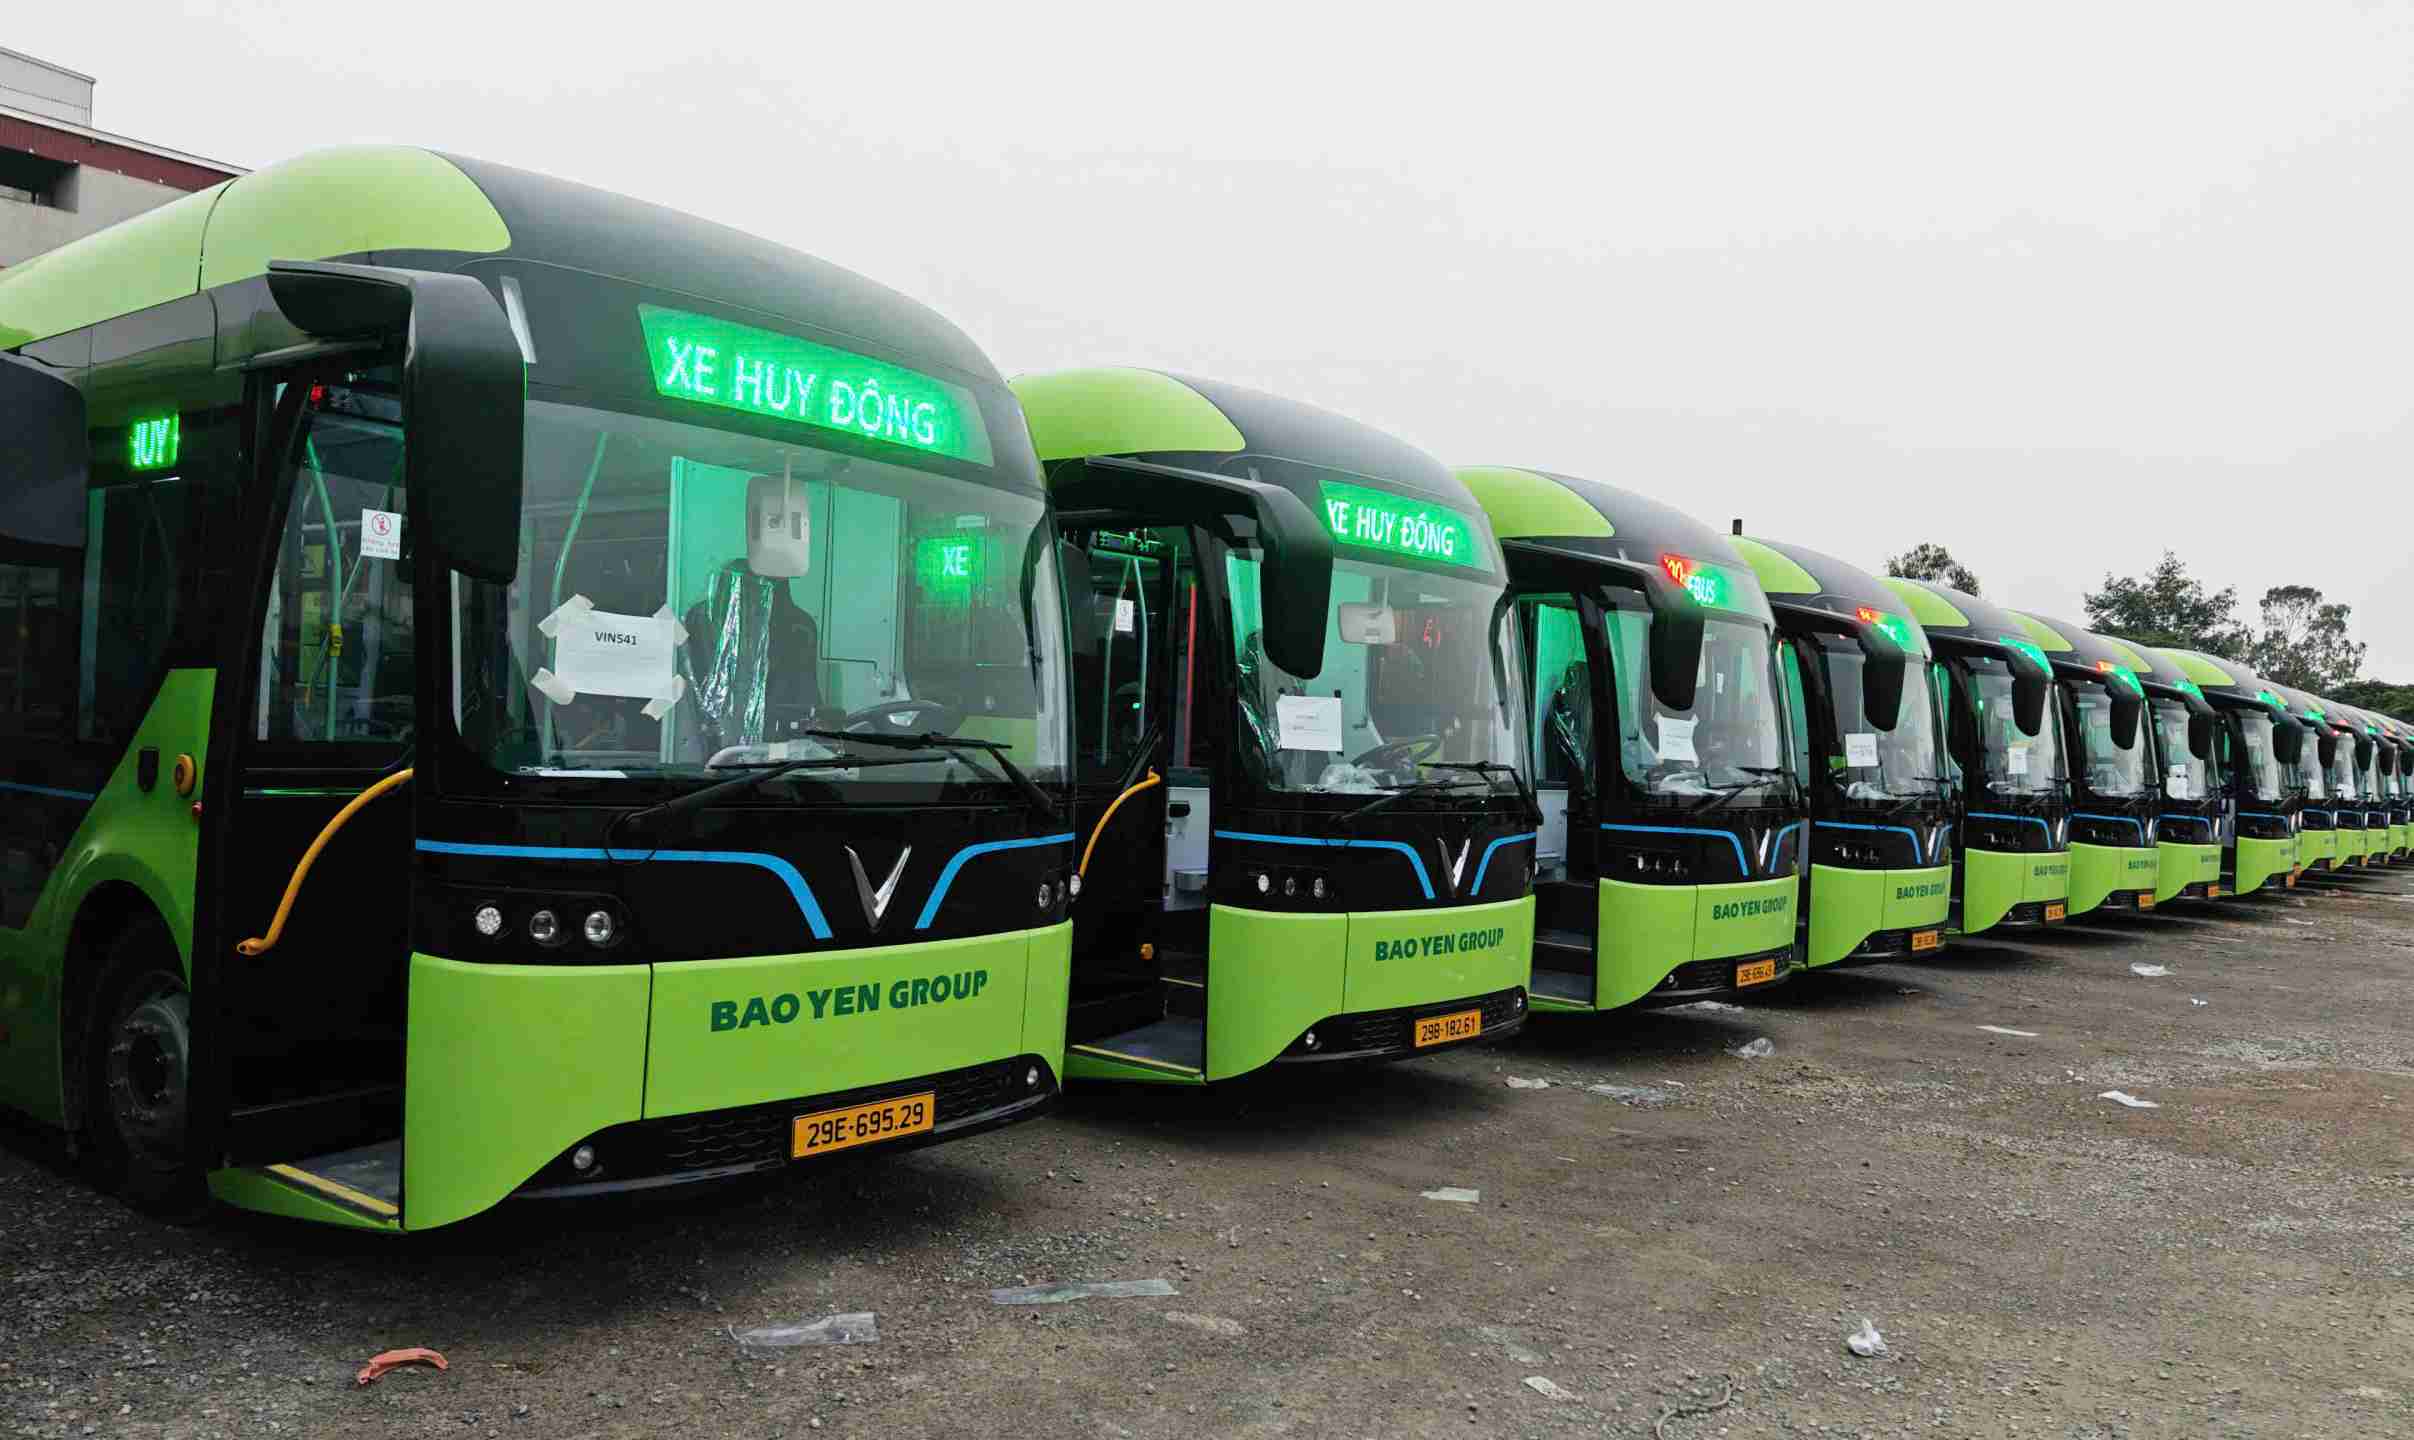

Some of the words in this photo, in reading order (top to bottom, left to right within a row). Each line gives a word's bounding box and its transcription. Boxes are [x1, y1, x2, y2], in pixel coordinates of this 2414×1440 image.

[666, 336, 716, 395] XE
[735, 354, 817, 416] HUY
[830, 378, 936, 445] ĐỘNG
[1355, 505, 1396, 544] HUY
[943, 545, 969, 577] XE
[595, 631, 637, 646] VIN541
[1713, 902, 1739, 920] BAO
[1740, 899, 1761, 917] YEN
[1375, 938, 1418, 962] BAO
[1420, 933, 1455, 957] YEN
[1458, 927, 1504, 952] GROUP
[711, 993, 800, 1032] BAO
[806, 982, 881, 1020] YEN
[888, 969, 988, 1009] GROUP
[807, 1102, 923, 1148] 29E-695.29
